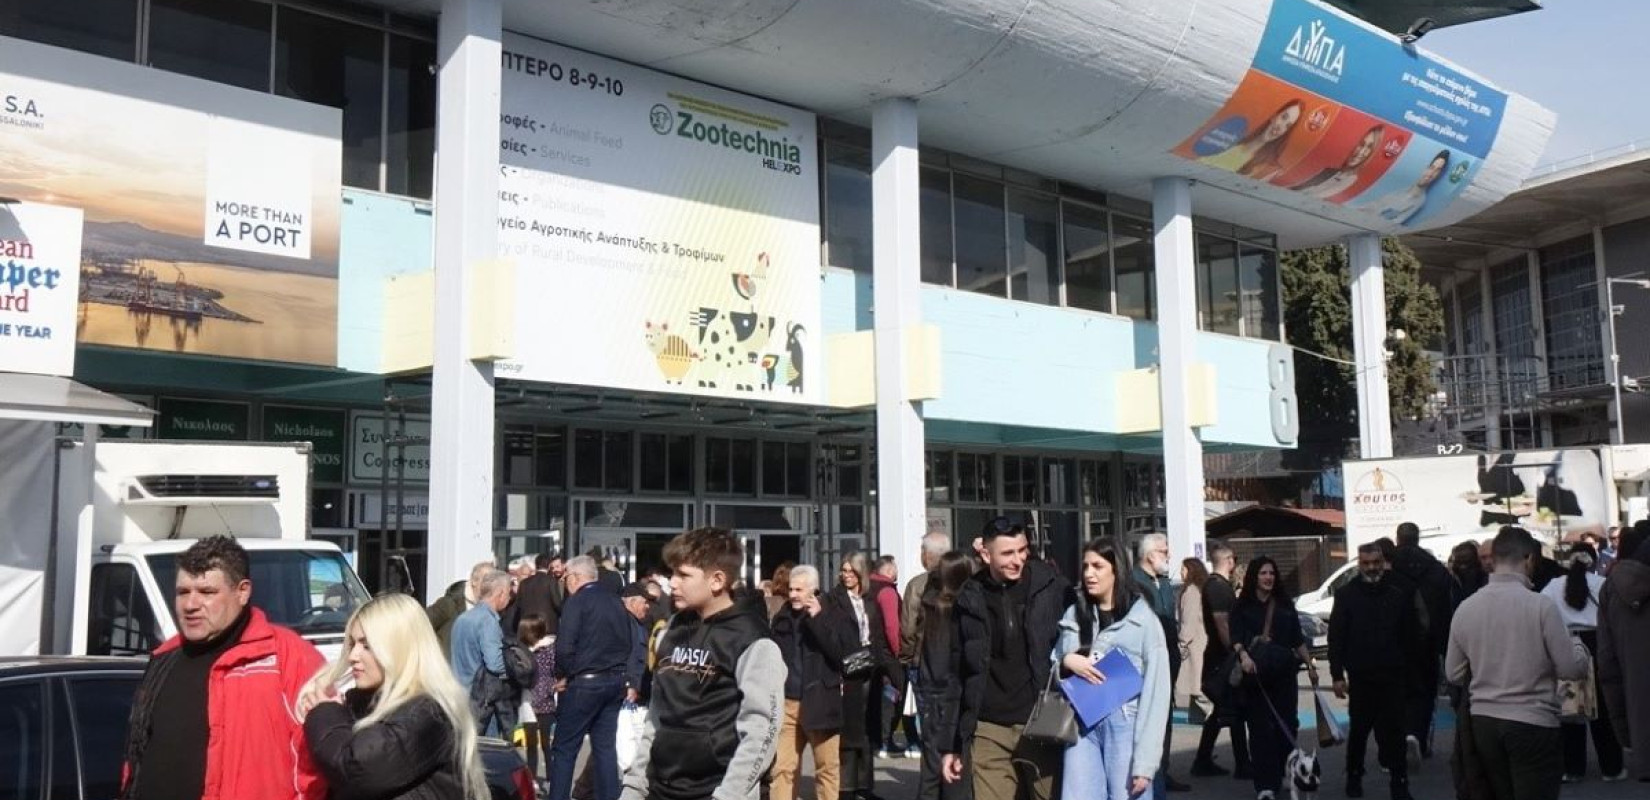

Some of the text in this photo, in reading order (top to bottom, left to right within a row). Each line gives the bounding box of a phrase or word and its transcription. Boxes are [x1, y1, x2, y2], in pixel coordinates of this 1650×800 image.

[569, 68, 623, 96] 8-9-10
[5, 95, 44, 118] S.A.
[677, 111, 800, 163] Zootechnia
[216, 200, 302, 225] MORE THAN
[216, 218, 301, 247] A PORT
[531, 219, 593, 243] Αγροτικής
[596, 231, 658, 254] Ανάπτυξης
[662, 242, 670, 254] &
[673, 243, 725, 263] Τροφίμων
[15, 324, 51, 339] YEAR
[1268, 343, 1299, 445] 8
